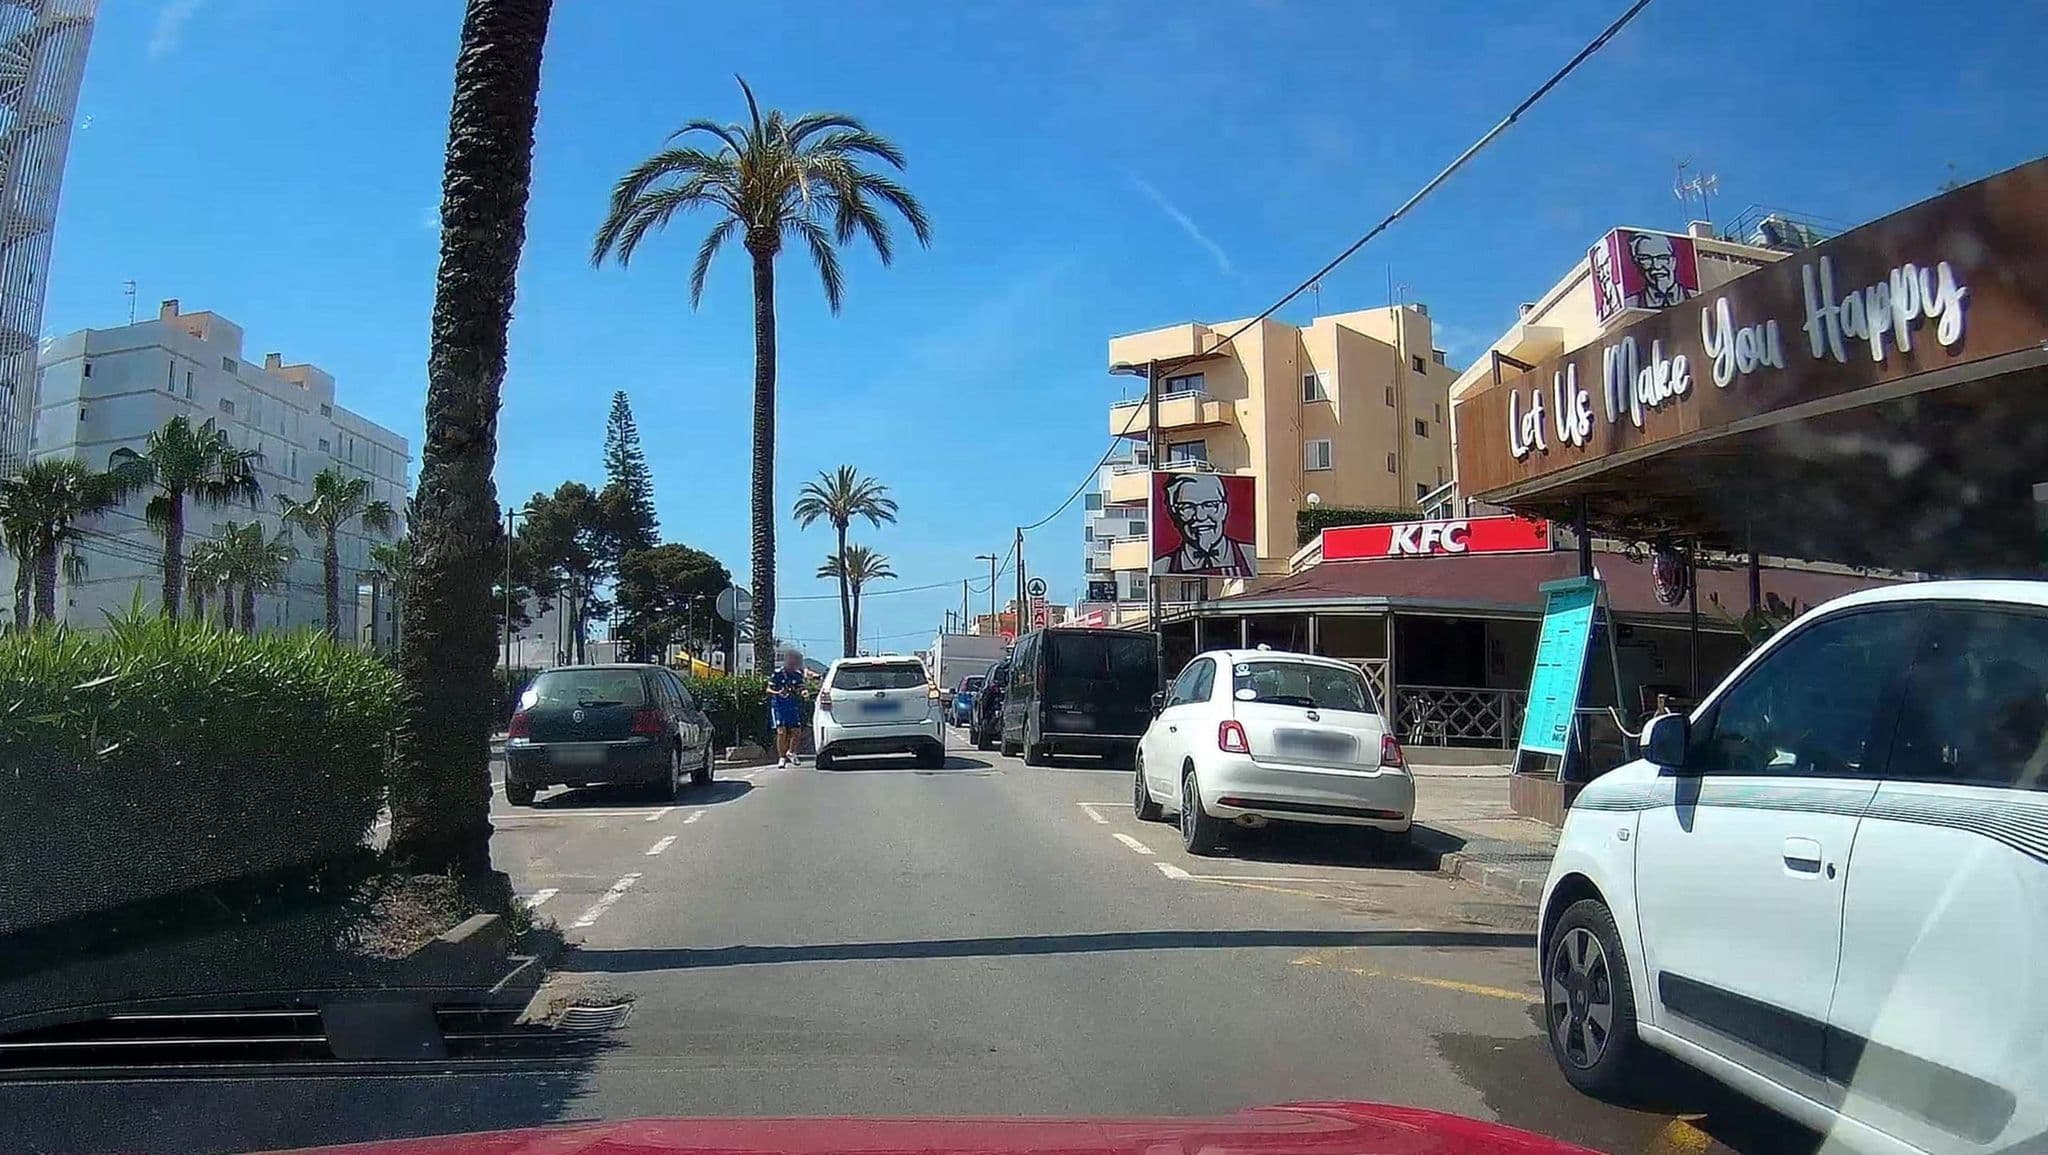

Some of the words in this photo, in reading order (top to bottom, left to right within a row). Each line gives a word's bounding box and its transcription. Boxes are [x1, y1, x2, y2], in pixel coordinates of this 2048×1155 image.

[1510, 388, 1547, 458] Let
[1554, 363, 1593, 447] Us
[1604, 336, 1692, 428] Make
[1702, 297, 1784, 388] You
[1802, 255, 1969, 364] Happy
[1387, 521, 1468, 554] KFC
